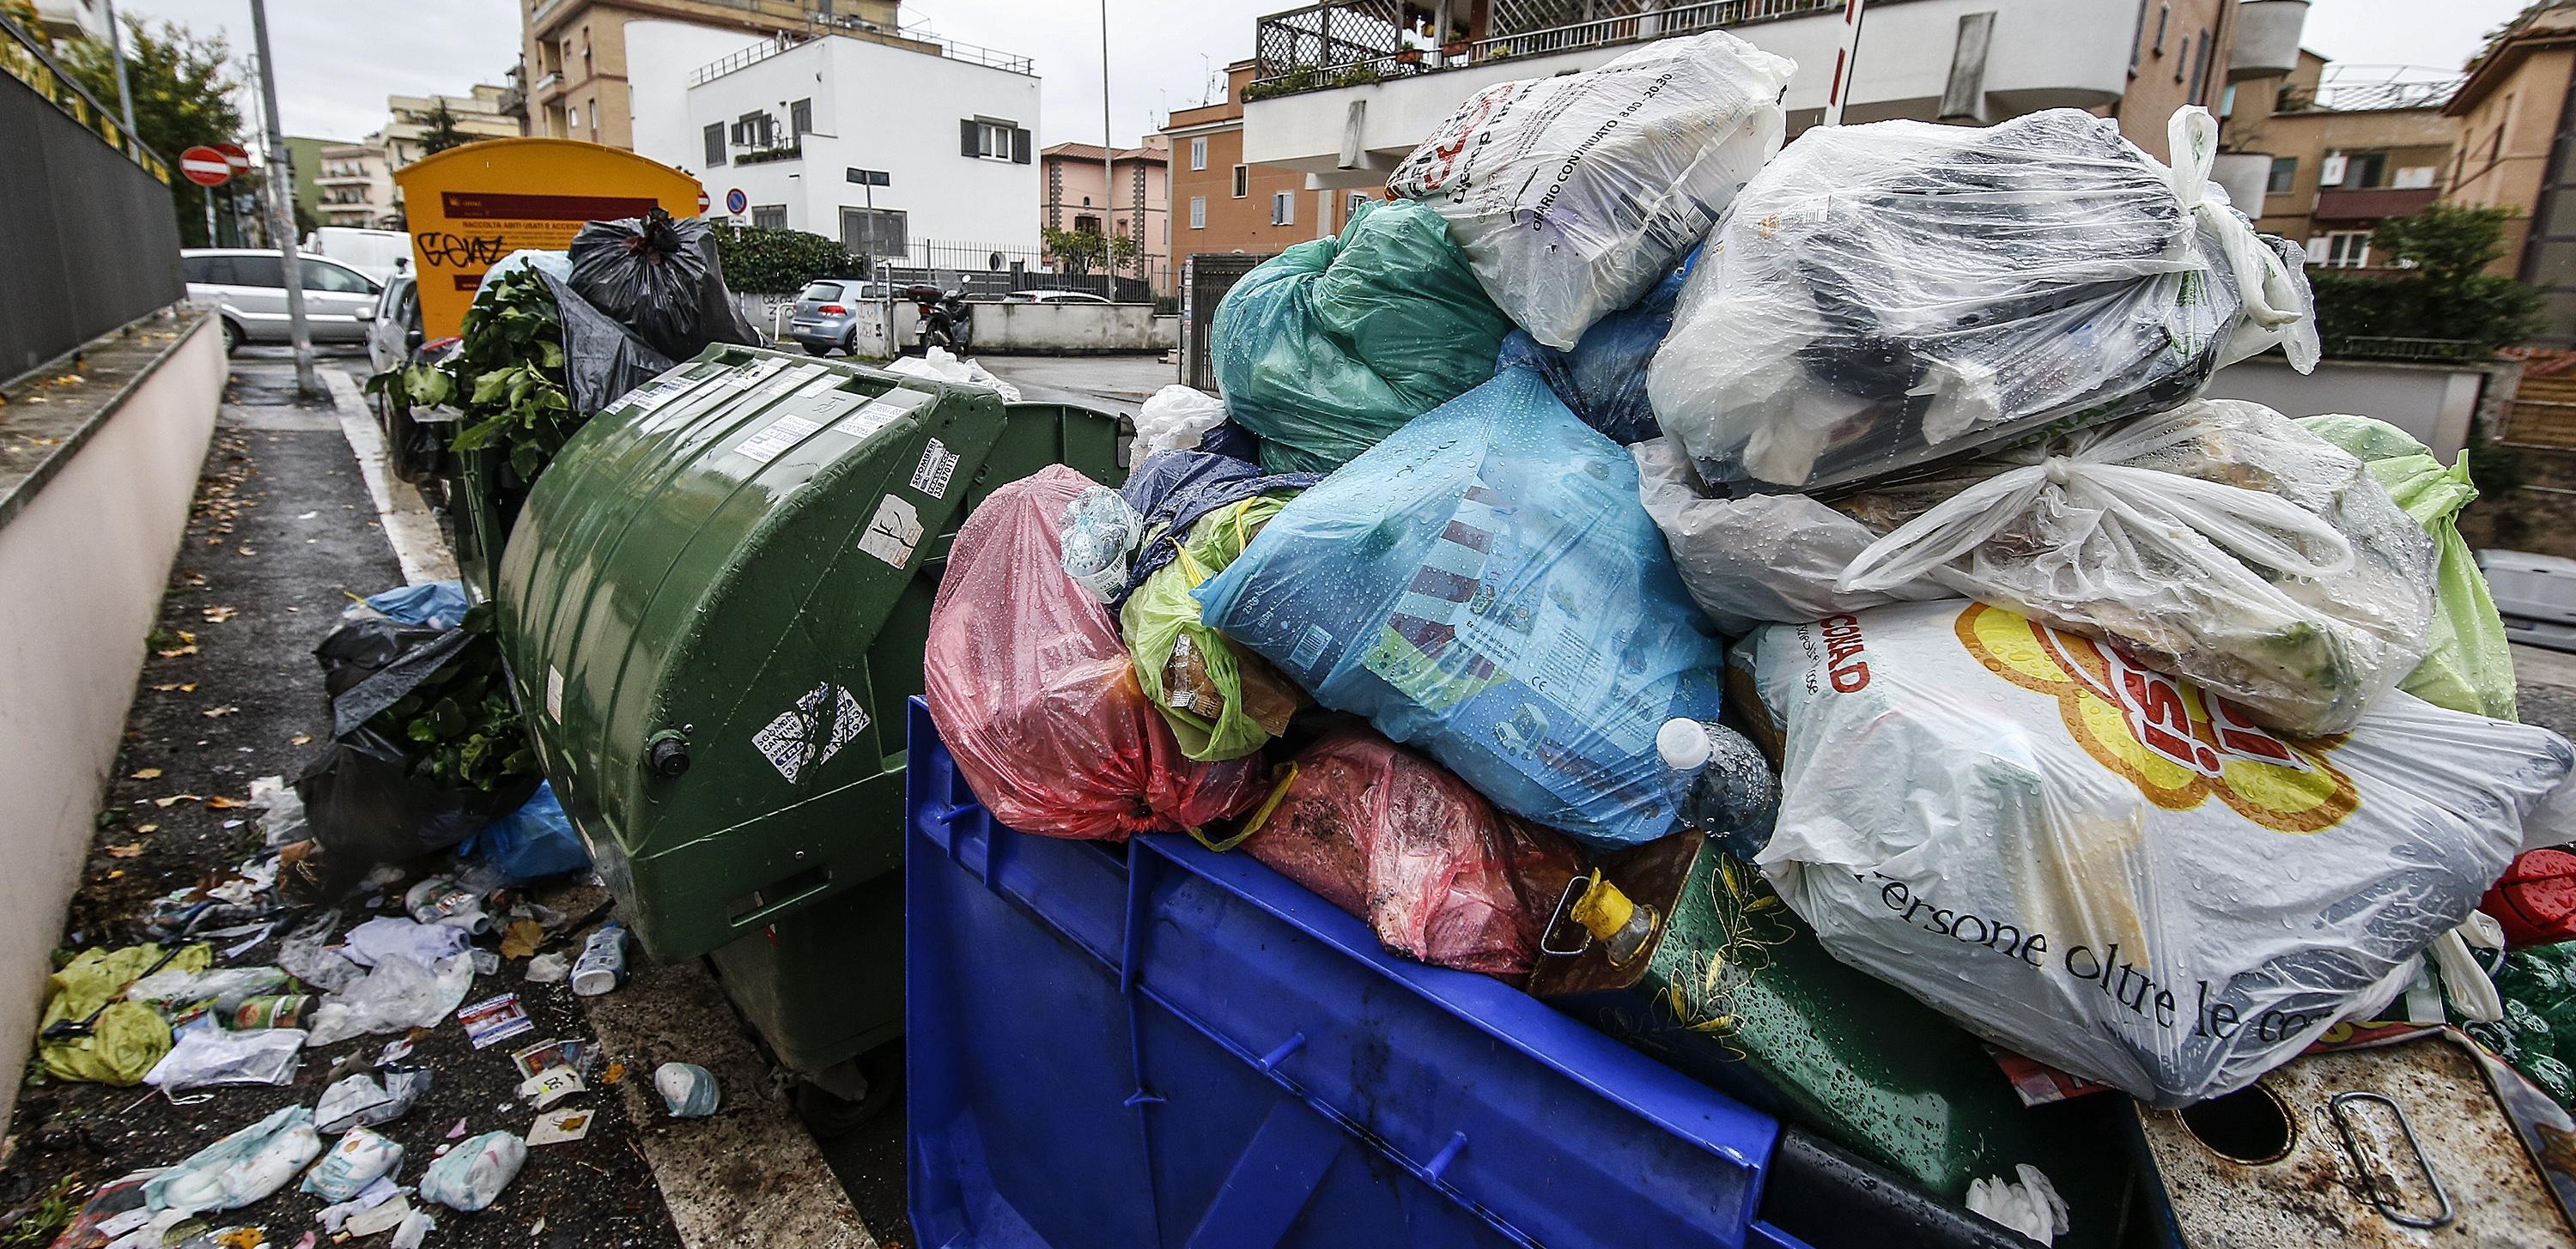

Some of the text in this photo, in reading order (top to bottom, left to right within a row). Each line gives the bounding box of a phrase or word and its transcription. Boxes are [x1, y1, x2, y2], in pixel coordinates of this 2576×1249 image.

[1533, 184, 1562, 232] ORARIO
[1557, 119, 1619, 183] CONTINUATO
[1643, 73, 1673, 99] 20.30
[462, 221, 501, 229] RACCOLTA
[503, 221, 522, 230] ABITI
[912, 440, 937, 486] SGOMBERI
[933, 482, 945, 497] 338
[1820, 615, 1871, 694] CONAD
[762, 720, 799, 752] CANTINE
[1853, 870, 2049, 968] ersone
[2064, 943, 2176, 1029] oltre
[2194, 979, 2241, 1040] le
